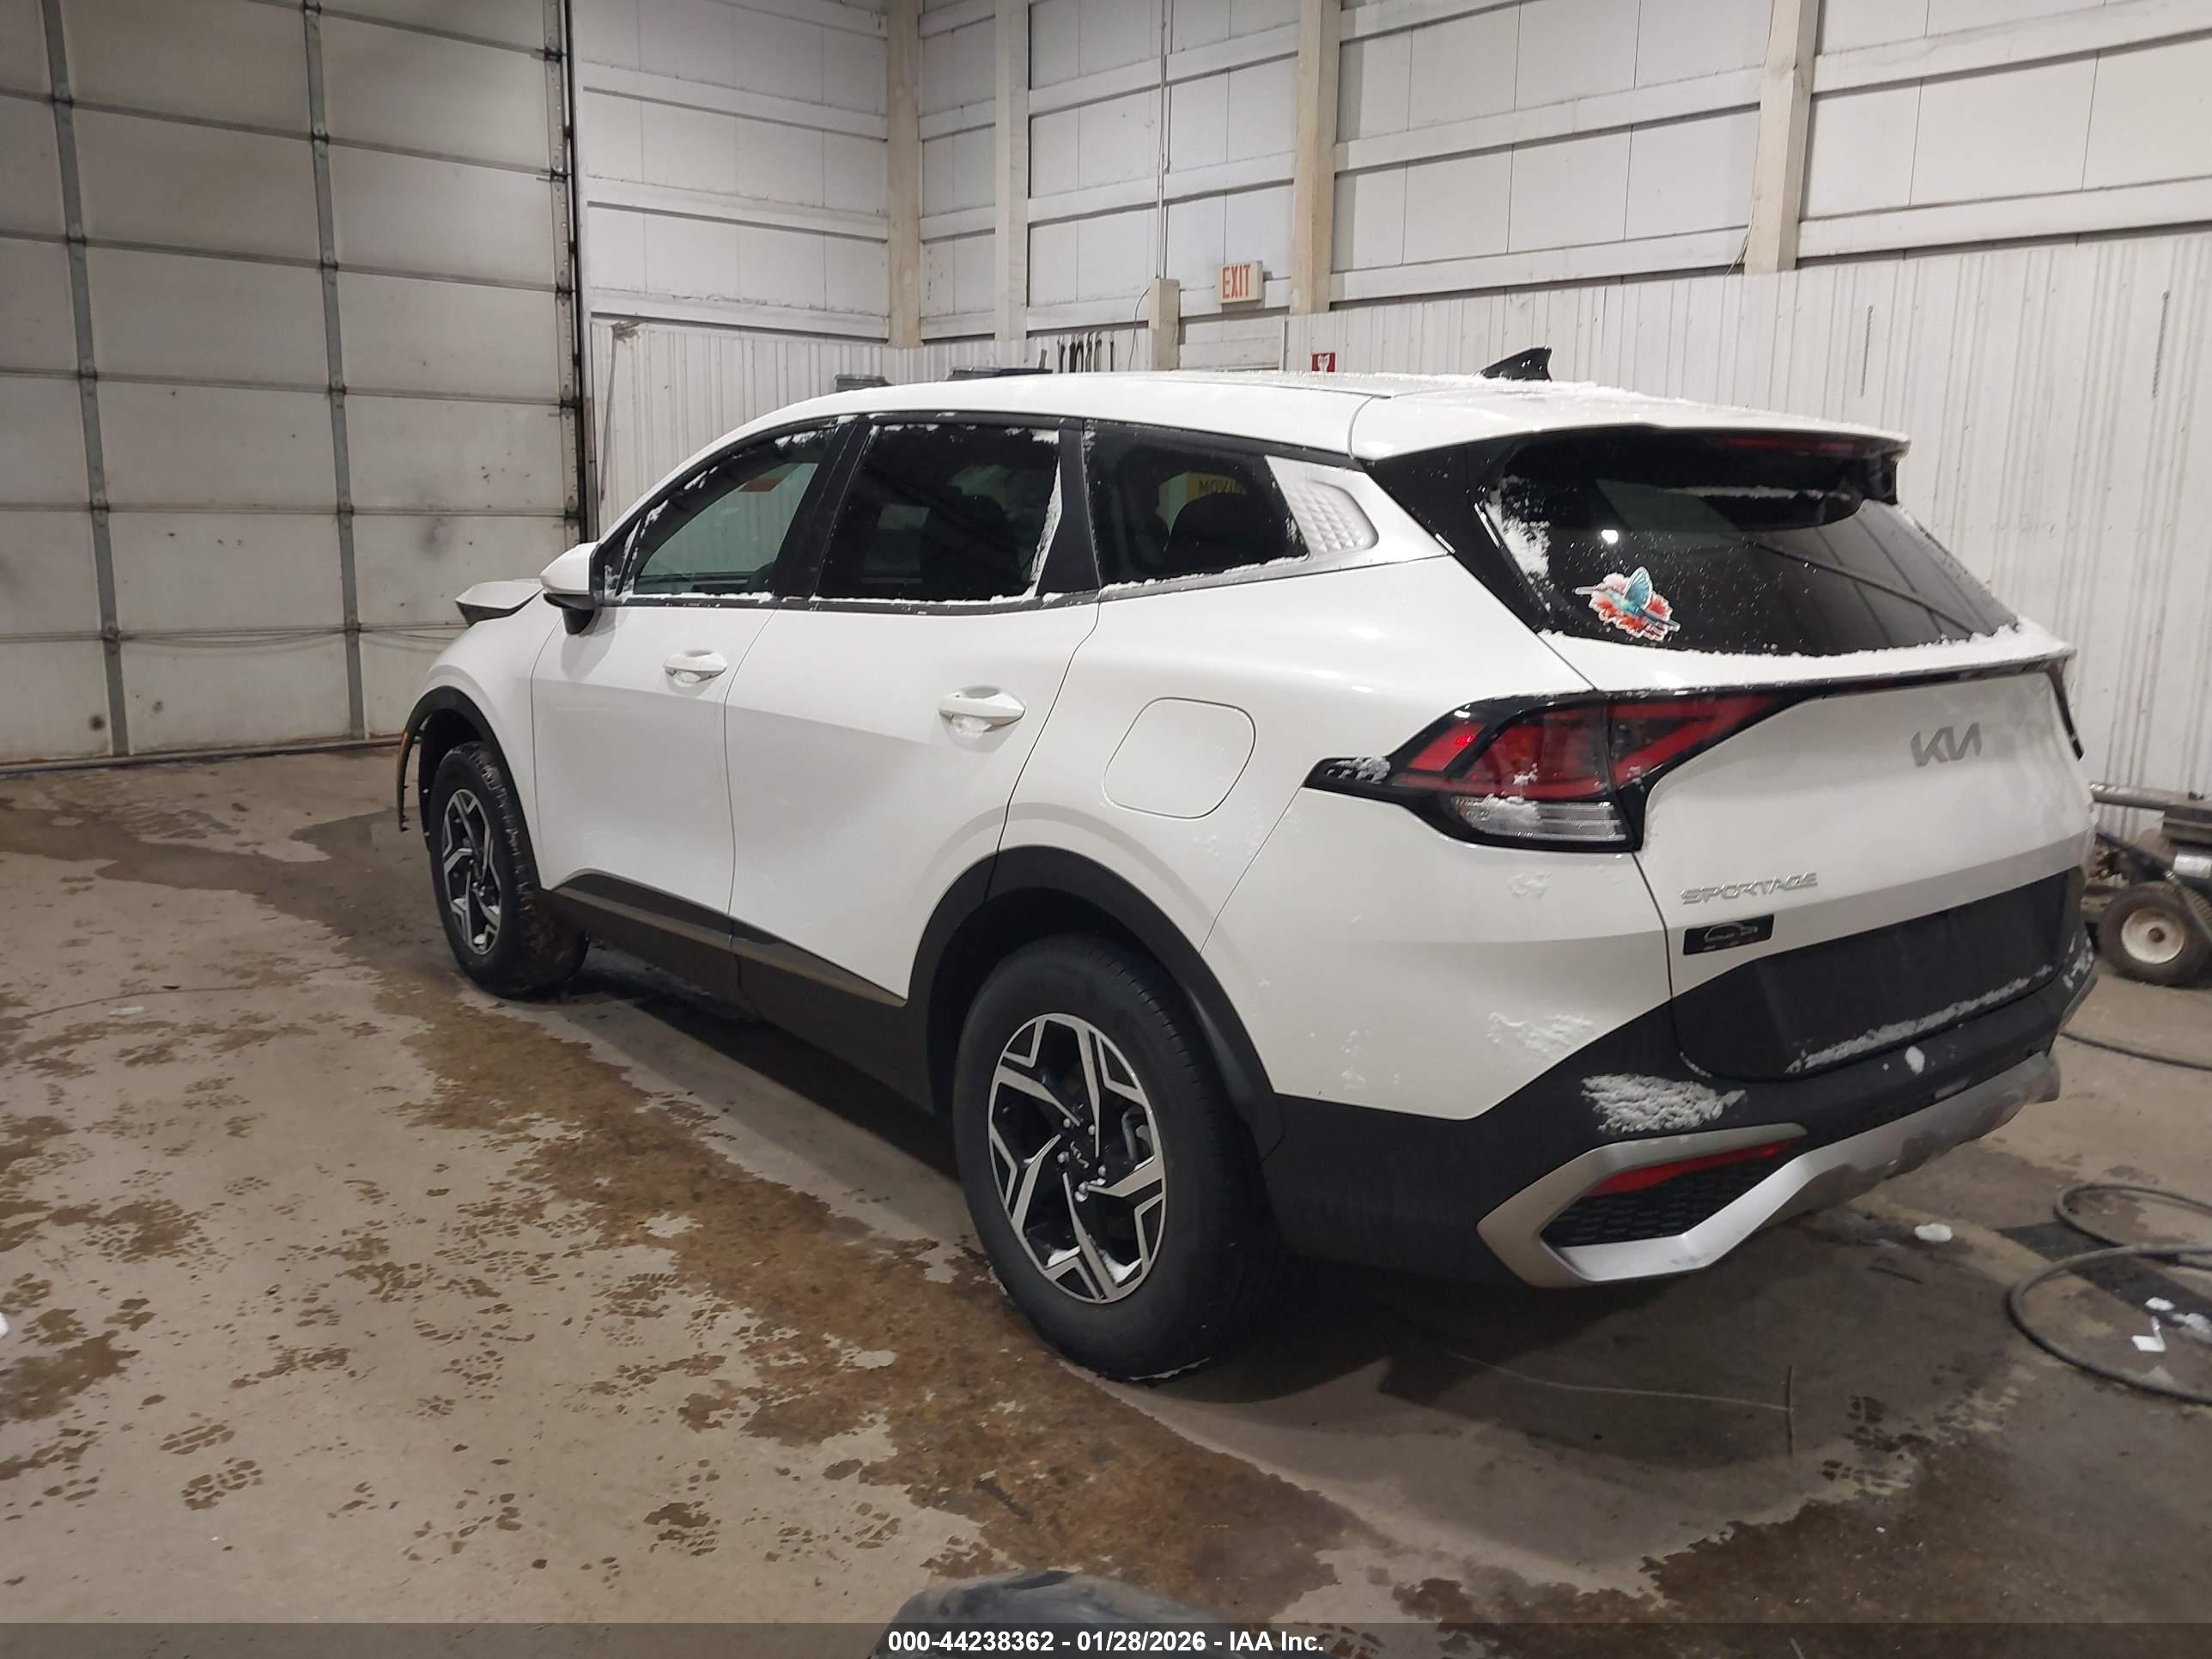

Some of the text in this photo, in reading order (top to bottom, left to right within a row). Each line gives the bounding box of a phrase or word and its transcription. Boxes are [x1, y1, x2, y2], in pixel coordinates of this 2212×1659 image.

[1222, 264, 1251, 299] EXIT
[1910, 722, 1983, 767] KIA
[1680, 872, 1819, 904] SPORTAGE
